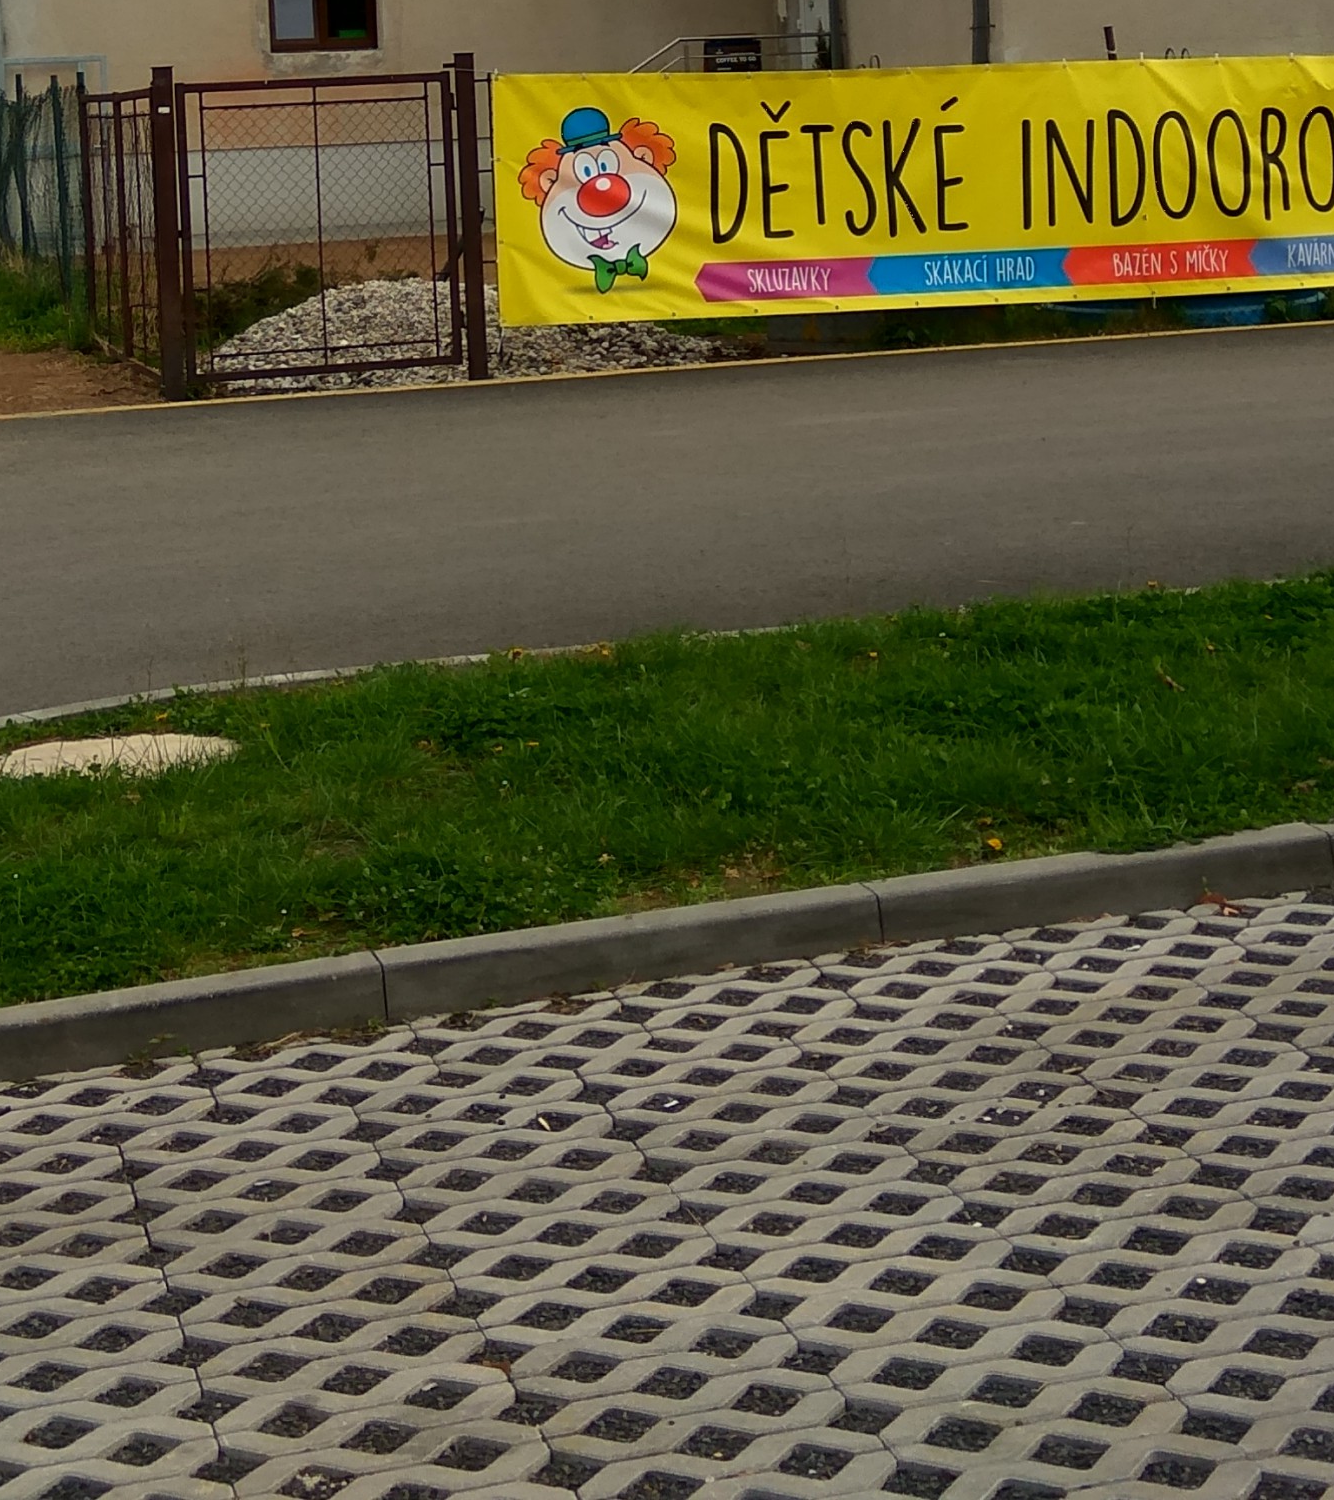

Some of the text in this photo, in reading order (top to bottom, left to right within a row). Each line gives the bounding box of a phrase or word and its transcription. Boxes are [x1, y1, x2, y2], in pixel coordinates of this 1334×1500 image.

[708, 96, 970, 244] DĚTSKÉ
[924, 255, 1035, 286] SKÁKACÍ HRAD
[1112, 244, 1229, 277] BAZÉN S MÍČKY
[747, 266, 832, 293] SKLUZAVKY
